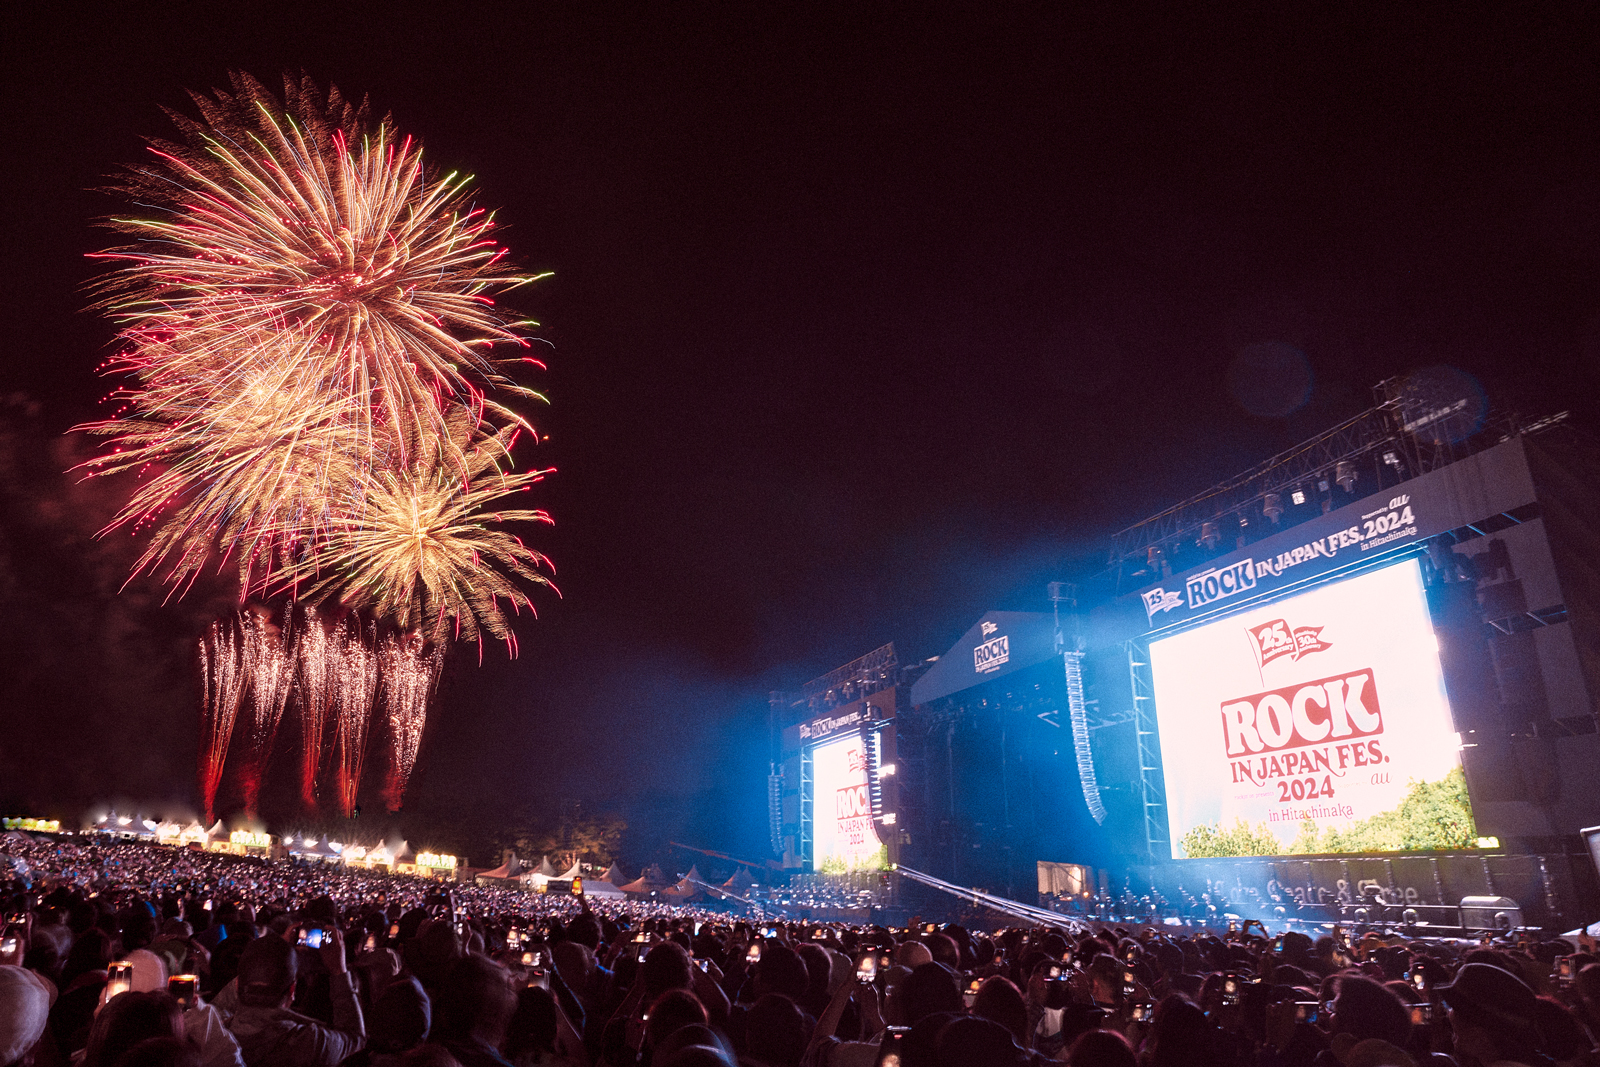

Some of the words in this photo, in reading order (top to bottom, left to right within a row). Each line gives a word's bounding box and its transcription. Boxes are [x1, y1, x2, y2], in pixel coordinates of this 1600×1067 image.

[1388, 494, 1410, 510] au
[1360, 542, 1369, 551] in
[1368, 526, 1417, 548] Hitachinaka
[1188, 560, 1256, 607] ROCK
[1255, 558, 1282, 578] IN
[1274, 538, 1336, 571] JAPAN
[1327, 525, 1364, 551] FES.
[1363, 505, 1415, 539] 2024
[975, 638, 1008, 665] ROCK
[1263, 643, 1294, 661] Anniversary
[1298, 635, 1317, 648] 30th
[1221, 672, 1381, 756] ROCK
[812, 718, 832, 738] ROCK
[1230, 760, 1265, 787] IN
[1257, 748, 1346, 779] JAPAN
[1336, 740, 1390, 769] FES.
[1277, 775, 1335, 802] 2024
[1370, 772, 1393, 785] au
[1268, 809, 1279, 822] in
[1281, 803, 1354, 821] Hitachinaka
[838, 821, 848, 834] IN
[845, 819, 865, 833] JAPAN
[850, 833, 865, 845] 2024
[1336, 879, 1352, 905] &
